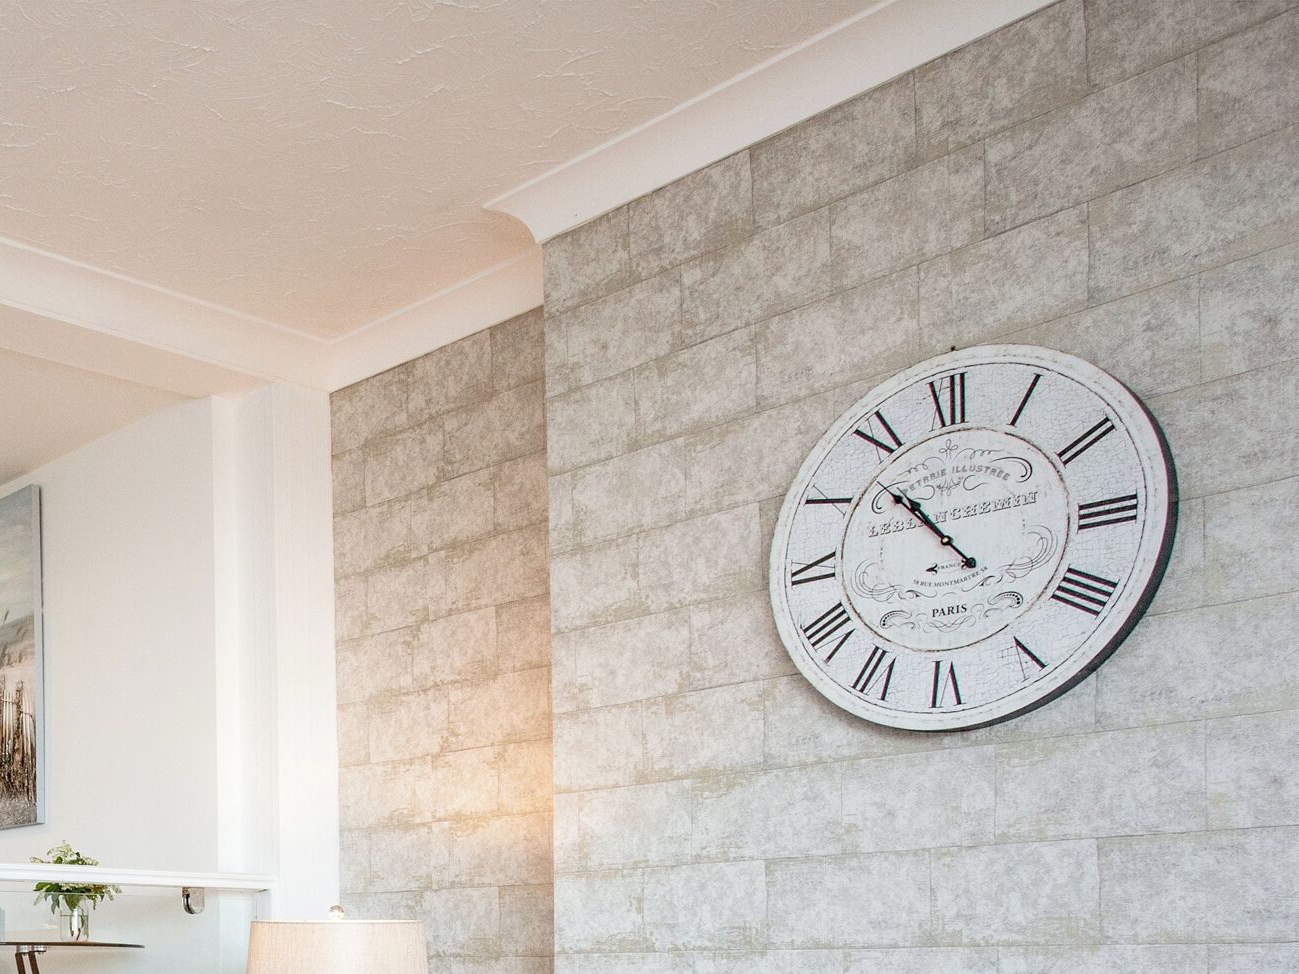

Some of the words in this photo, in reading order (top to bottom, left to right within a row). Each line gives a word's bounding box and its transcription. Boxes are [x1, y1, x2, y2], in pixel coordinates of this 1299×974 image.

[926, 371, 969, 433] XII
[1006, 373, 1043, 428] I
[852, 408, 906, 466] XI
[1054, 412, 1117, 469] II
[803, 482, 855, 520] X
[1077, 488, 1139, 535] III
[789, 548, 838, 591] IX
[934, 571, 980, 587] MONTMARTRE
[800, 600, 857, 666] VIII
[932, 603, 967, 618] PARIS
[848, 643, 901, 703] VII
[928, 660, 967, 709] VI
